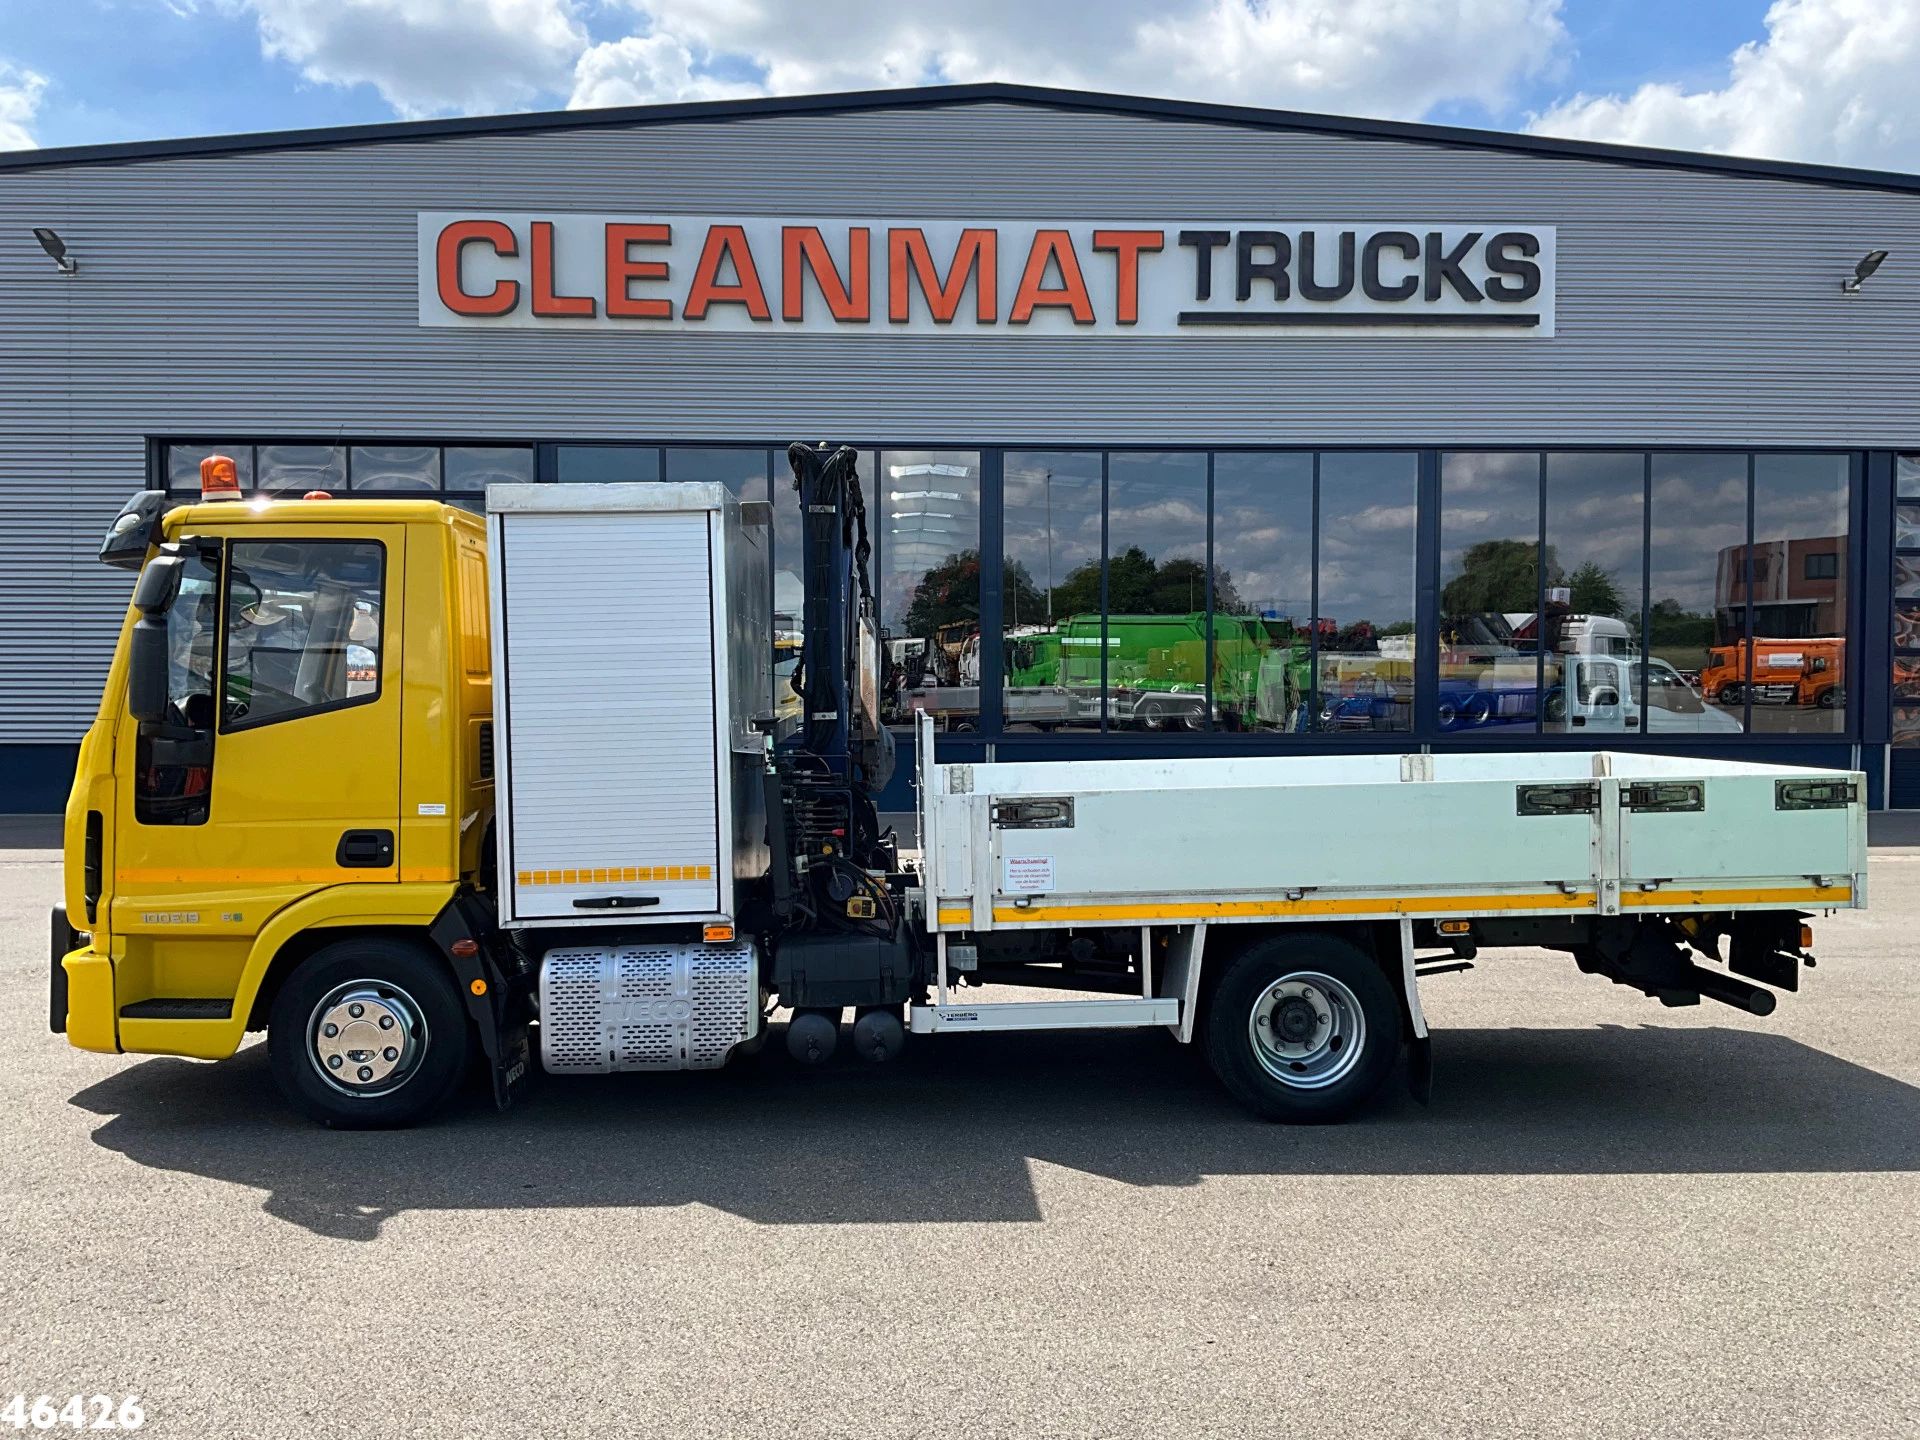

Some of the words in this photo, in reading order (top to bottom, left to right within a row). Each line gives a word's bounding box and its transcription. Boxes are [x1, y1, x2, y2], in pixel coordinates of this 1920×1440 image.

[436, 219, 1164, 326] CLEANMAT
[1178, 229, 1542, 303] TRUCKS
[602, 1000, 690, 1021] IVECO
